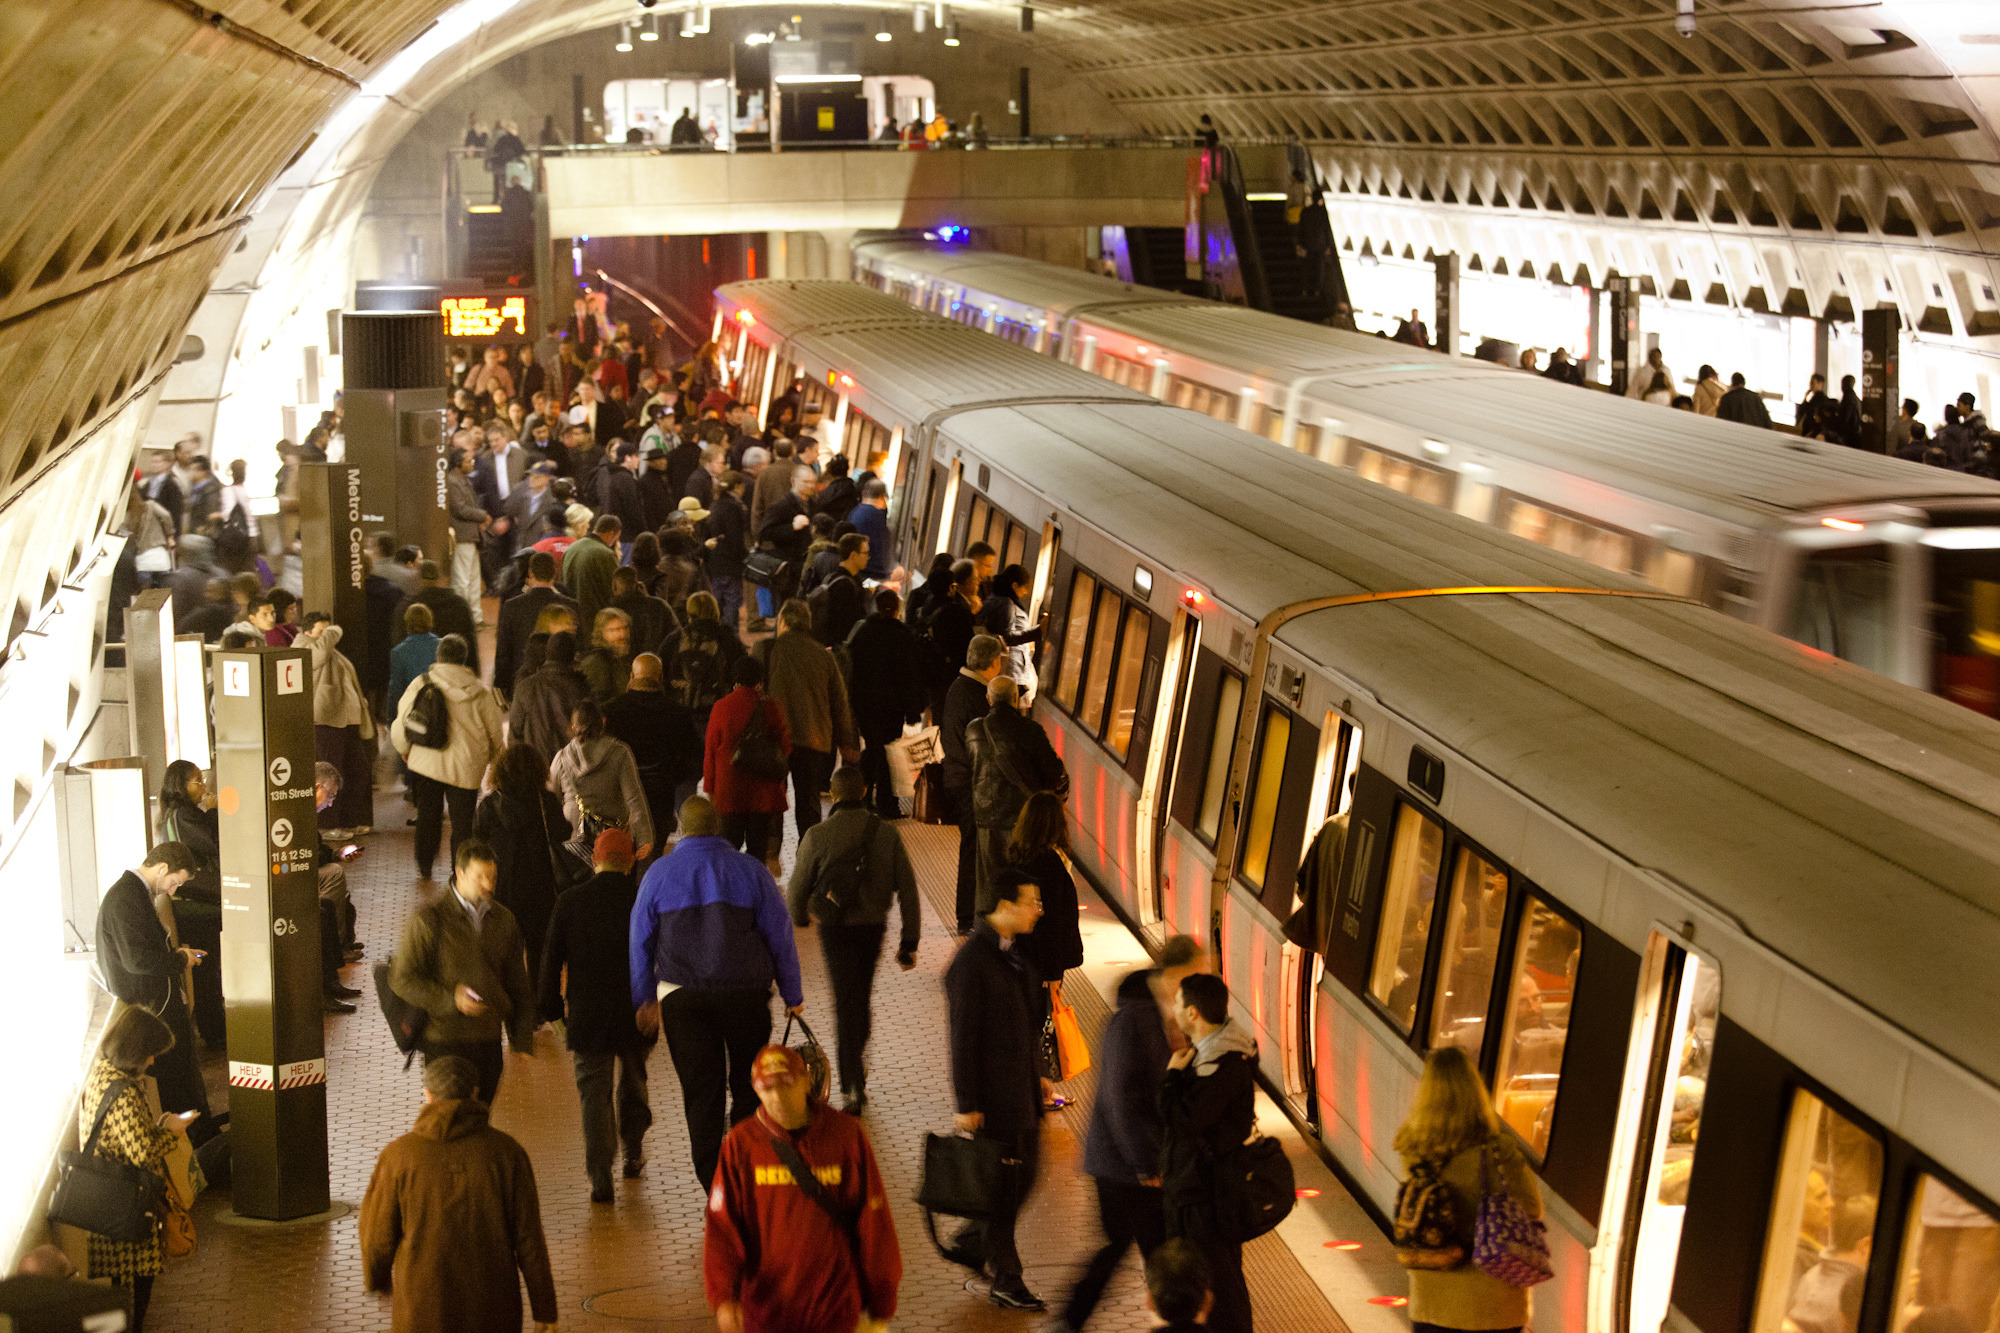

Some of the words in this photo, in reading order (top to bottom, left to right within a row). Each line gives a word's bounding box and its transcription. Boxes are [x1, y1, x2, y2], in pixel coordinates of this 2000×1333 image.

[436, 458, 448, 510] Center
[348, 469, 360, 522] Metro
[350, 528, 364, 589] Center
[270, 790, 287, 801] 13th
[289, 787, 313, 799] Street
[272, 853, 279, 862] 11
[281, 851, 287, 861] &
[288, 850, 297, 860] 12
[299, 849, 312, 859] Sts
[290, 862, 309, 872] lines
[240, 1065, 261, 1076] HELP
[291, 1063, 314, 1075] HELP
